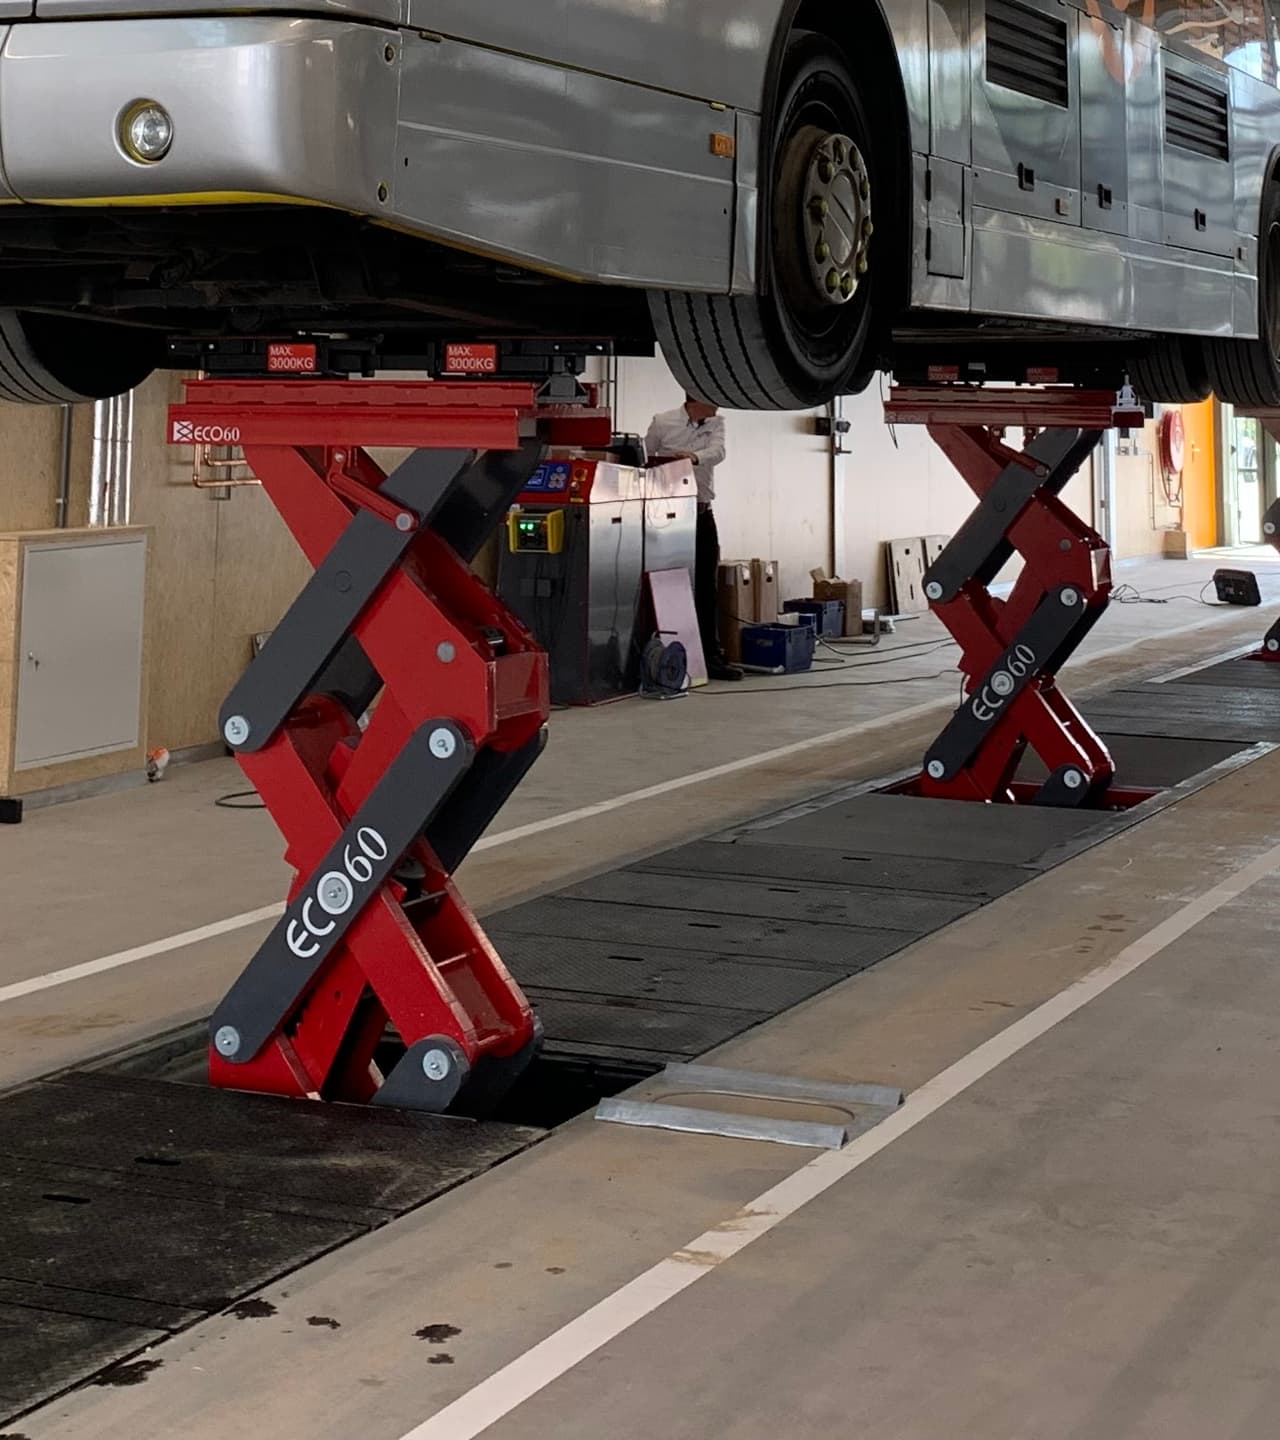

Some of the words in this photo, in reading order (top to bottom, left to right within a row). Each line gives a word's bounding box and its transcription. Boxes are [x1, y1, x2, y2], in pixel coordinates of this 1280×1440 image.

[270, 357, 314, 369] 3000KG
[448, 357, 494, 370] 3000KG
[193, 426, 241, 442] ECO60
[971, 643, 1038, 723] ECO60
[285, 825, 389, 960] ECO60
